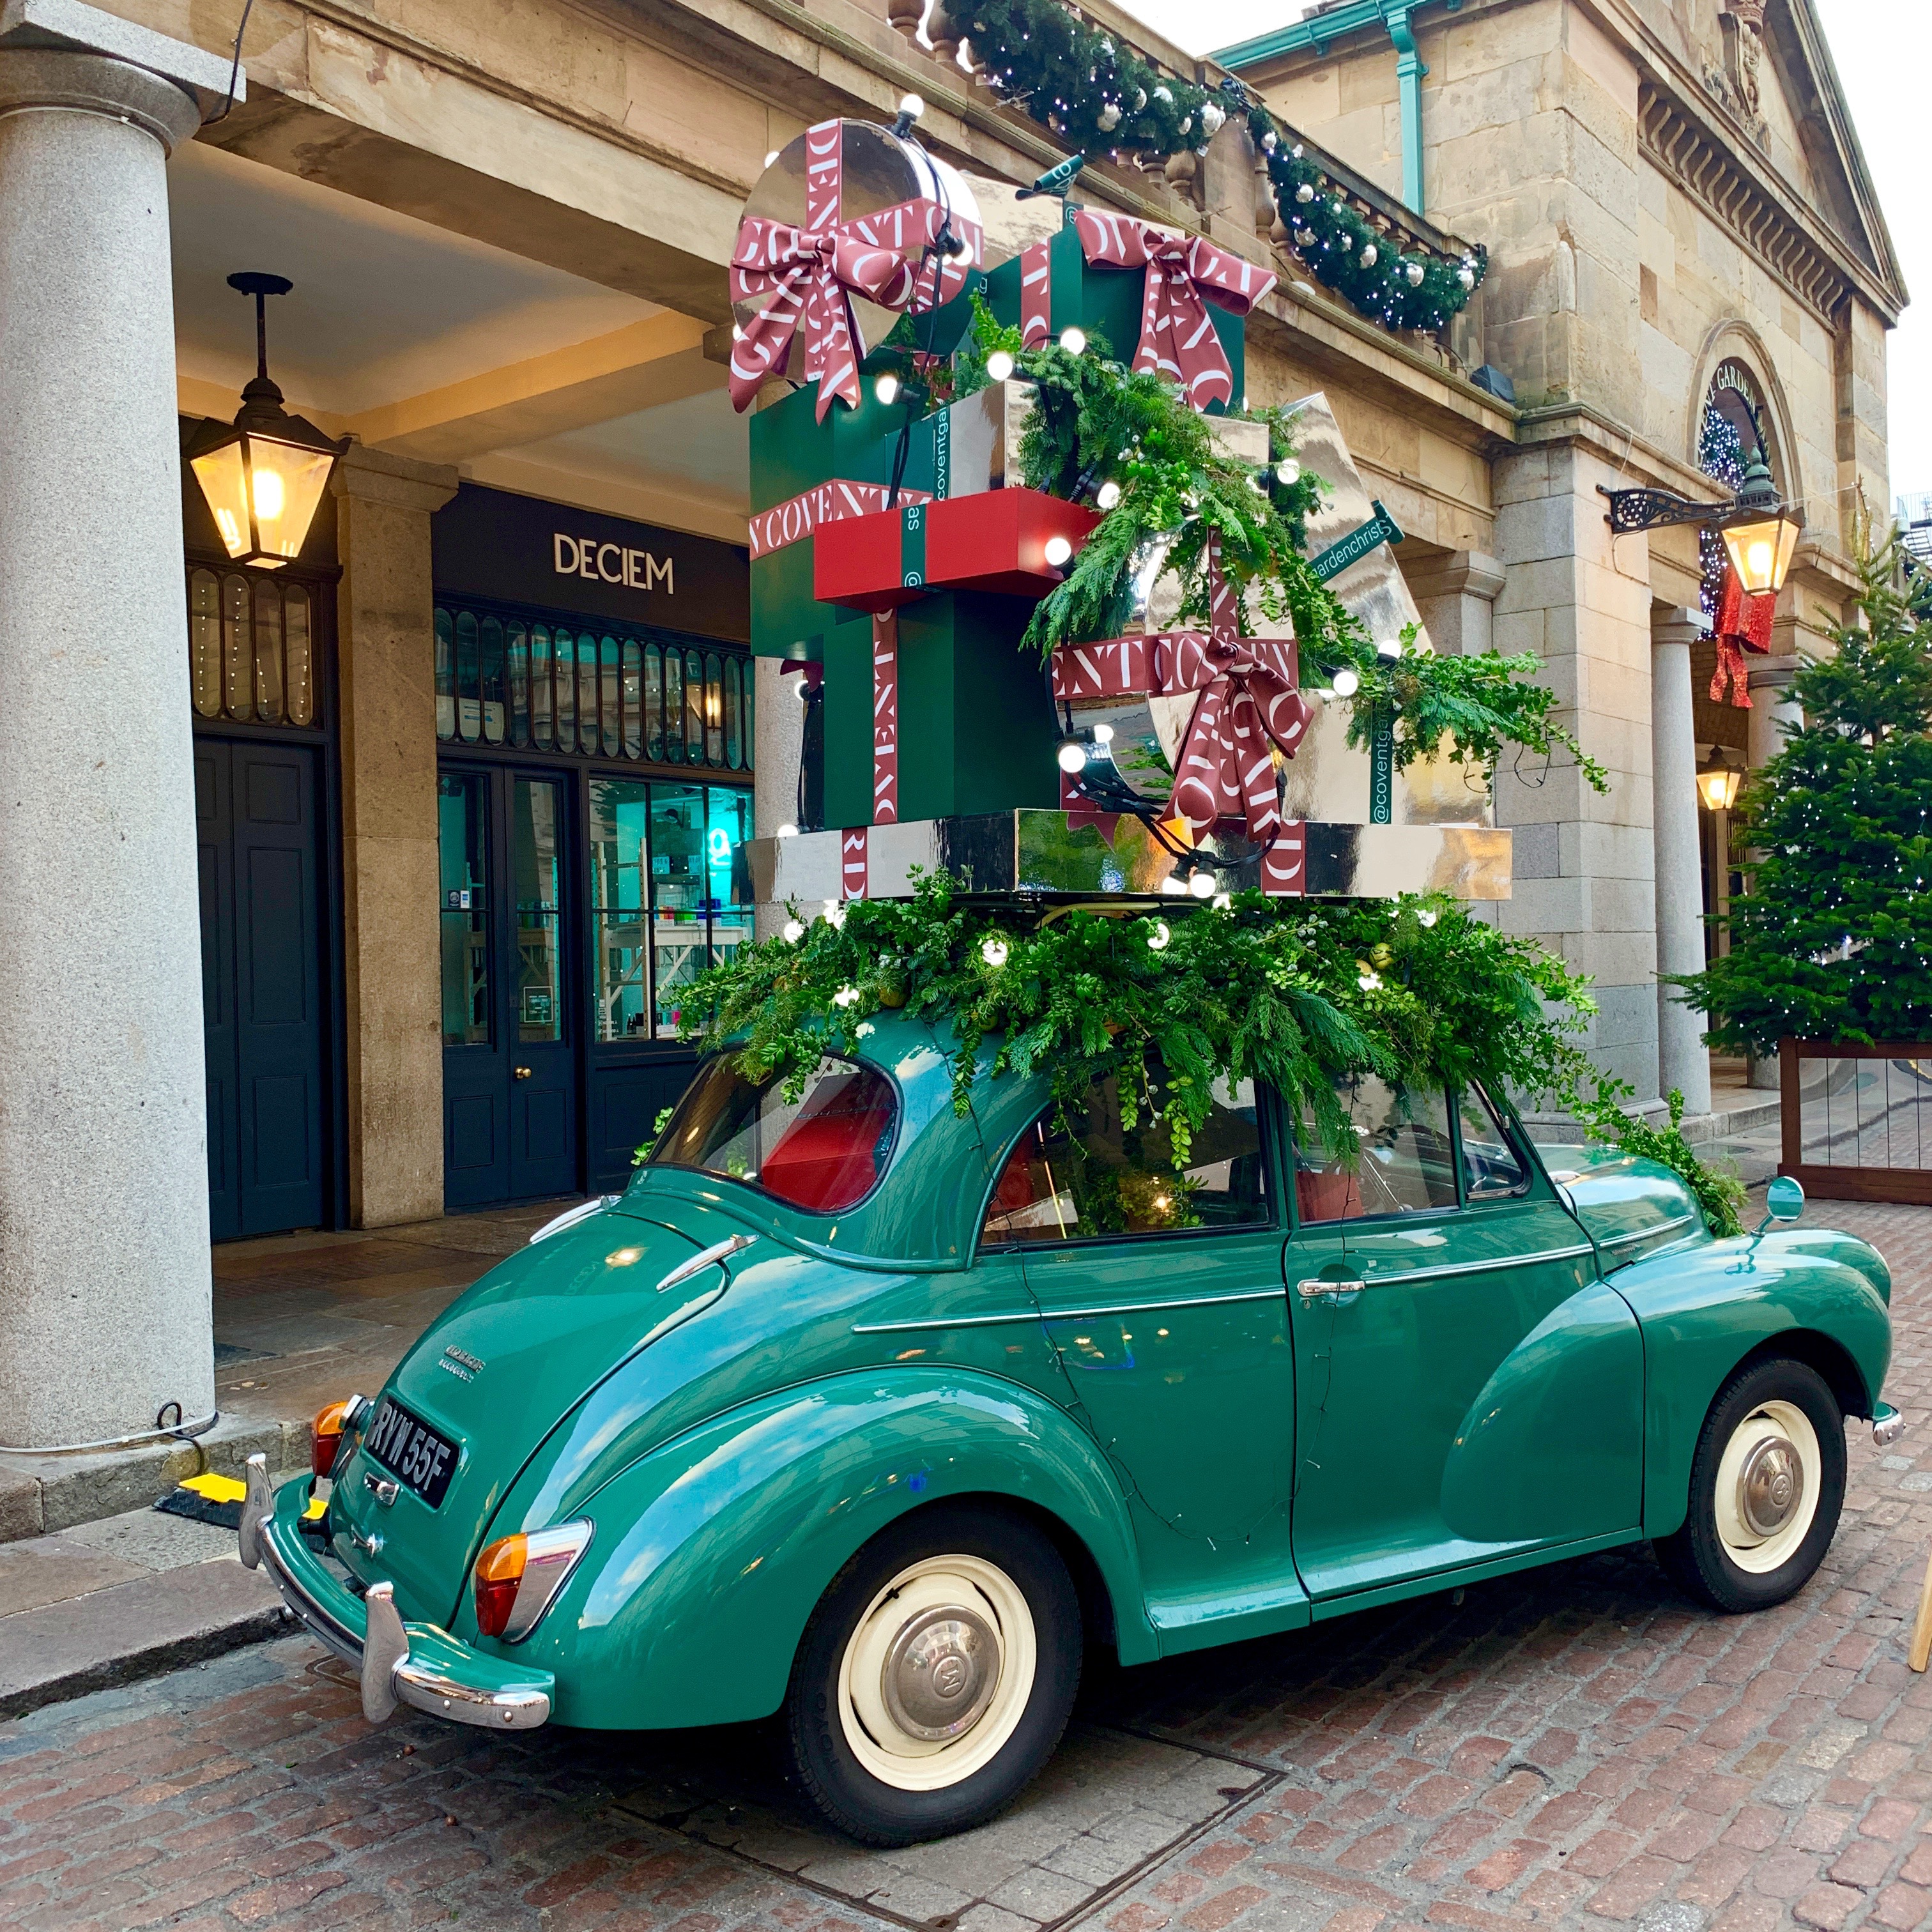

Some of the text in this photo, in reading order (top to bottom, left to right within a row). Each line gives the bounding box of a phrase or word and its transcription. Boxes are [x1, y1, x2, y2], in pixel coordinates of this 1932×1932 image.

[554, 533, 674, 595] DECIEM
[369, 1402, 451, 1491] RYW 55F
